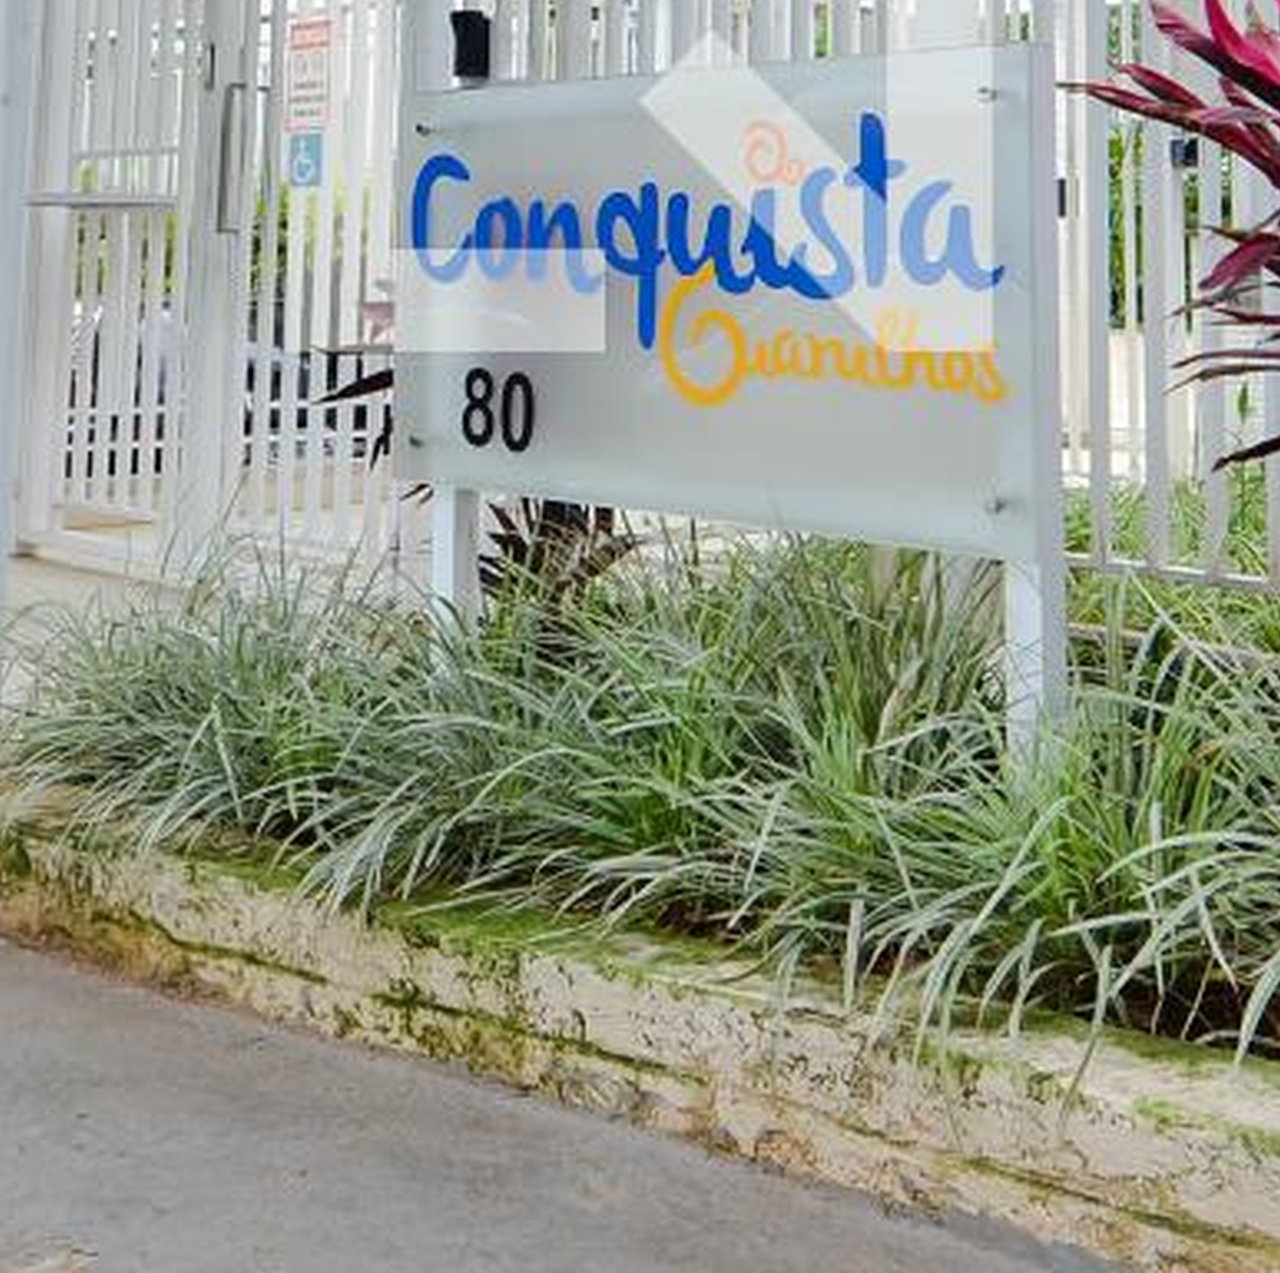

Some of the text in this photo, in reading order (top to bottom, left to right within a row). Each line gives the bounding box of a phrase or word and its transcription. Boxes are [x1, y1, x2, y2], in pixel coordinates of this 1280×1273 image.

[411, 113, 1006, 350] Conquista
[660, 264, 1010, 407] Guarulhos
[462, 367, 536, 453] 80
